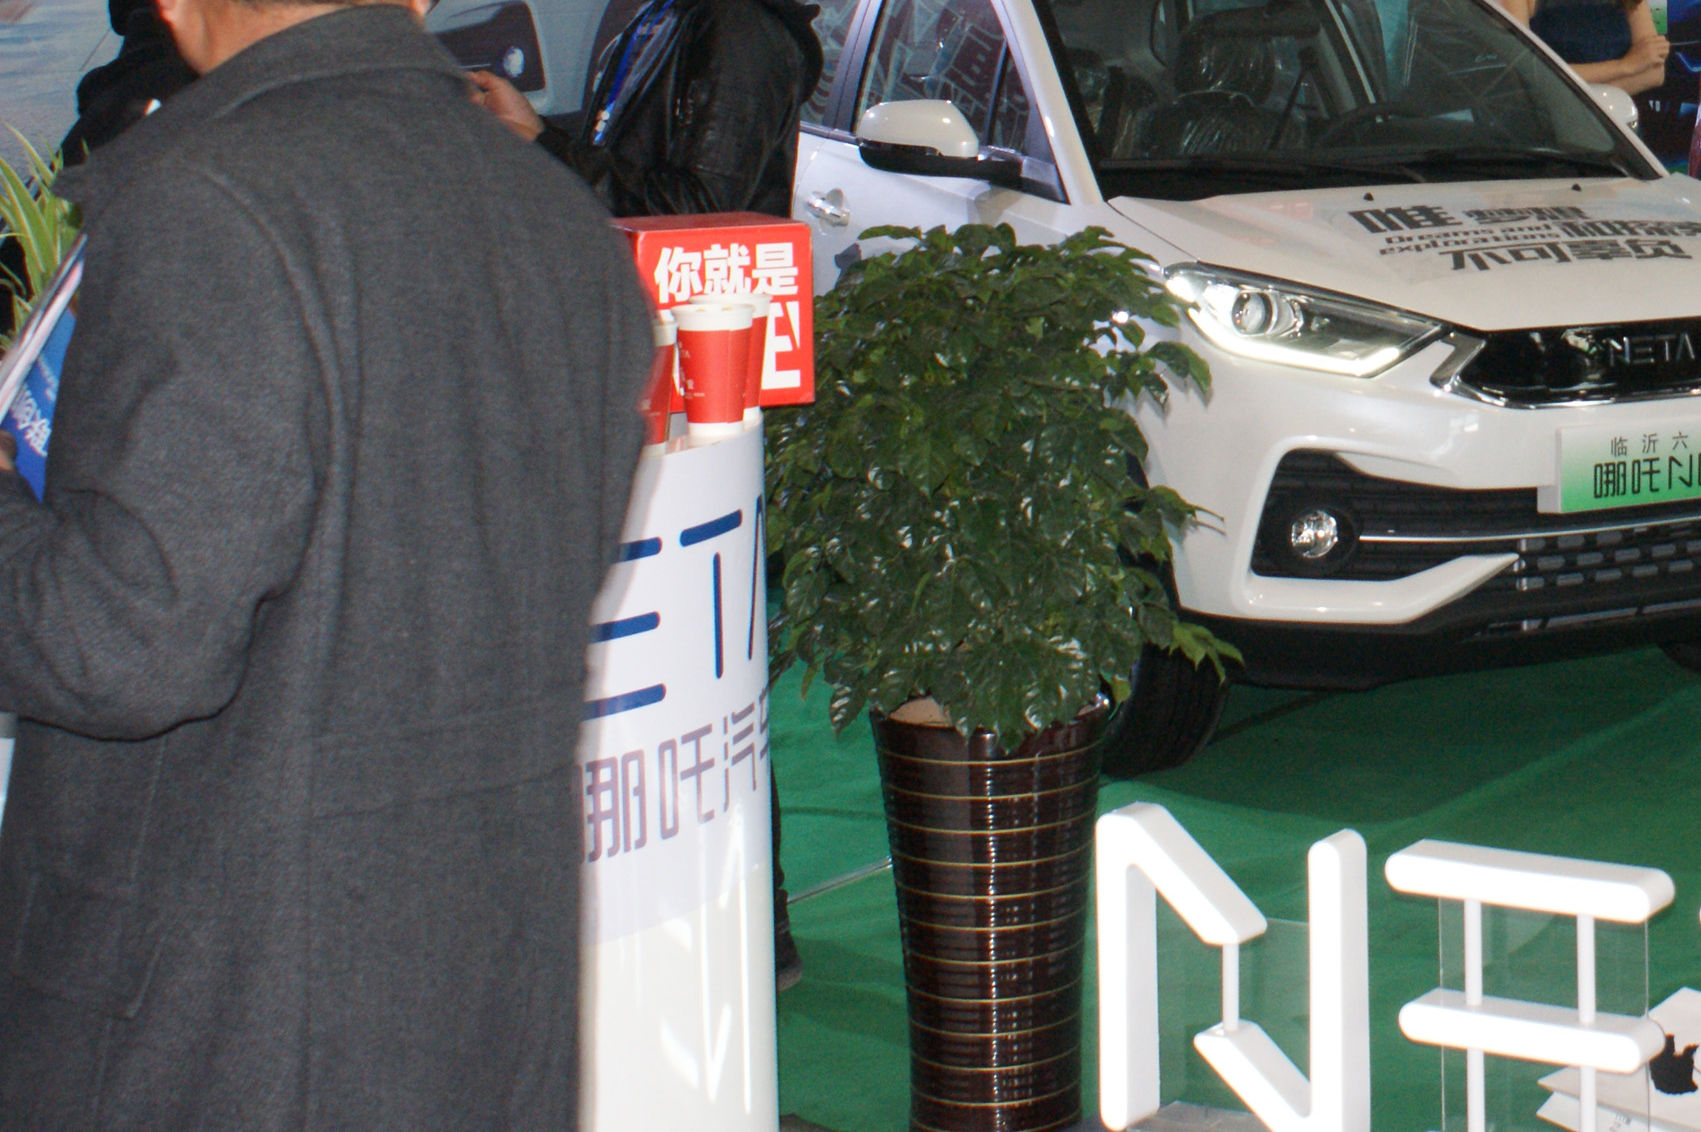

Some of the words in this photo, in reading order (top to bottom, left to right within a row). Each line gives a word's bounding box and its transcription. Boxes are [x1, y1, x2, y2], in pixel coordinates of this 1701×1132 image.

[654, 242, 800, 304] 你就是
[1604, 330, 1697, 368] NETA
